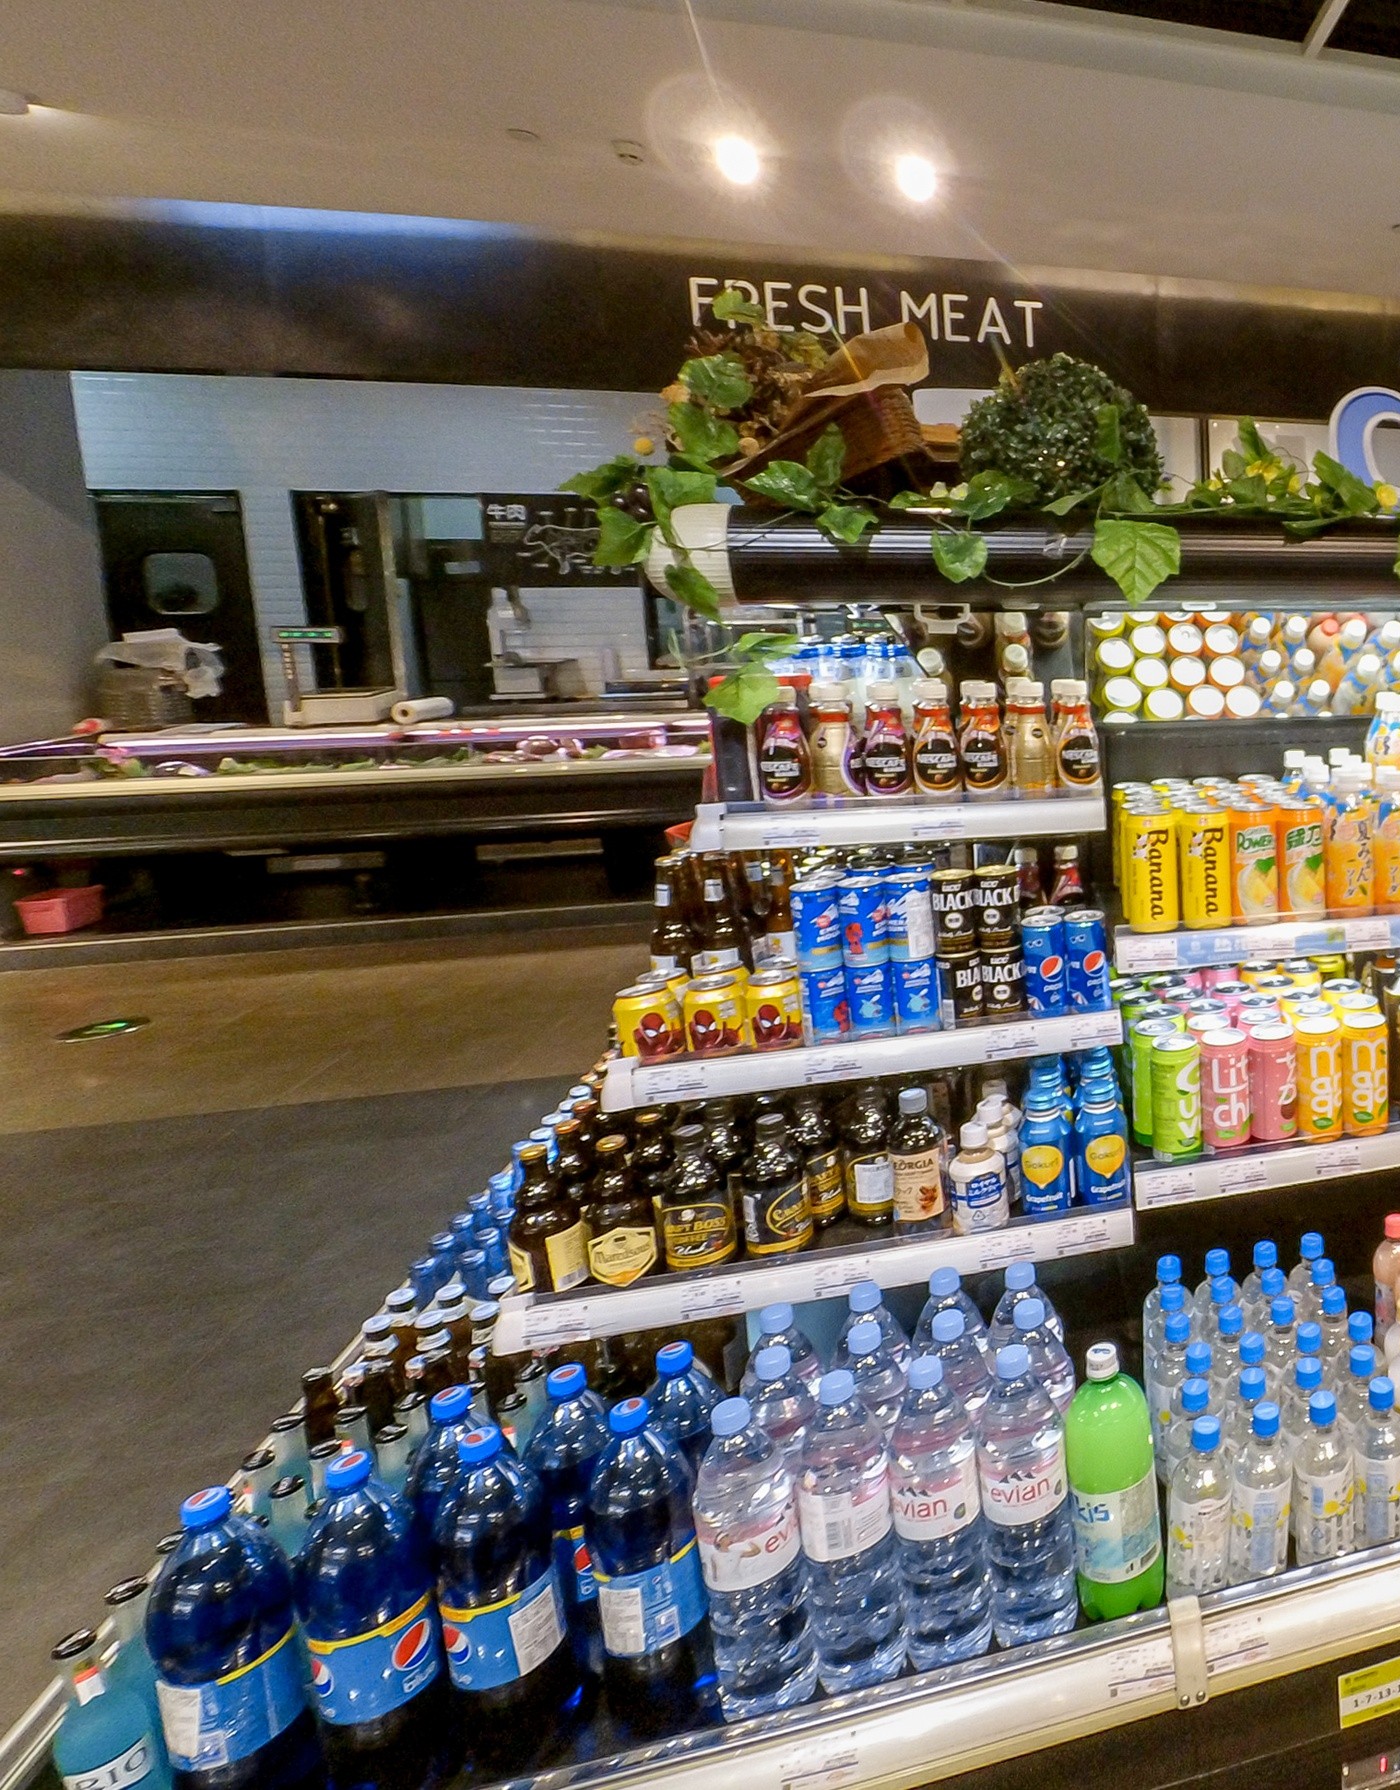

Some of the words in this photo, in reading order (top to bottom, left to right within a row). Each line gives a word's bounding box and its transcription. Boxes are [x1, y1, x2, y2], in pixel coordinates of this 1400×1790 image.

[901, 291, 1043, 348] MEAT
[486, 504, 527, 521] 牛肉
[1236, 831, 1273, 852] POWER
[1148, 828, 1169, 921] Banana
[1203, 827, 1224, 918] Banana
[932, 889, 974, 912] BLACK
[955, 965, 981, 989] BLA
[982, 964, 1021, 984] BLACK
[892, 1157, 934, 1171] EORGIA
[693, 1216, 726, 1231] BOSS
[990, 1476, 1051, 1505] evian
